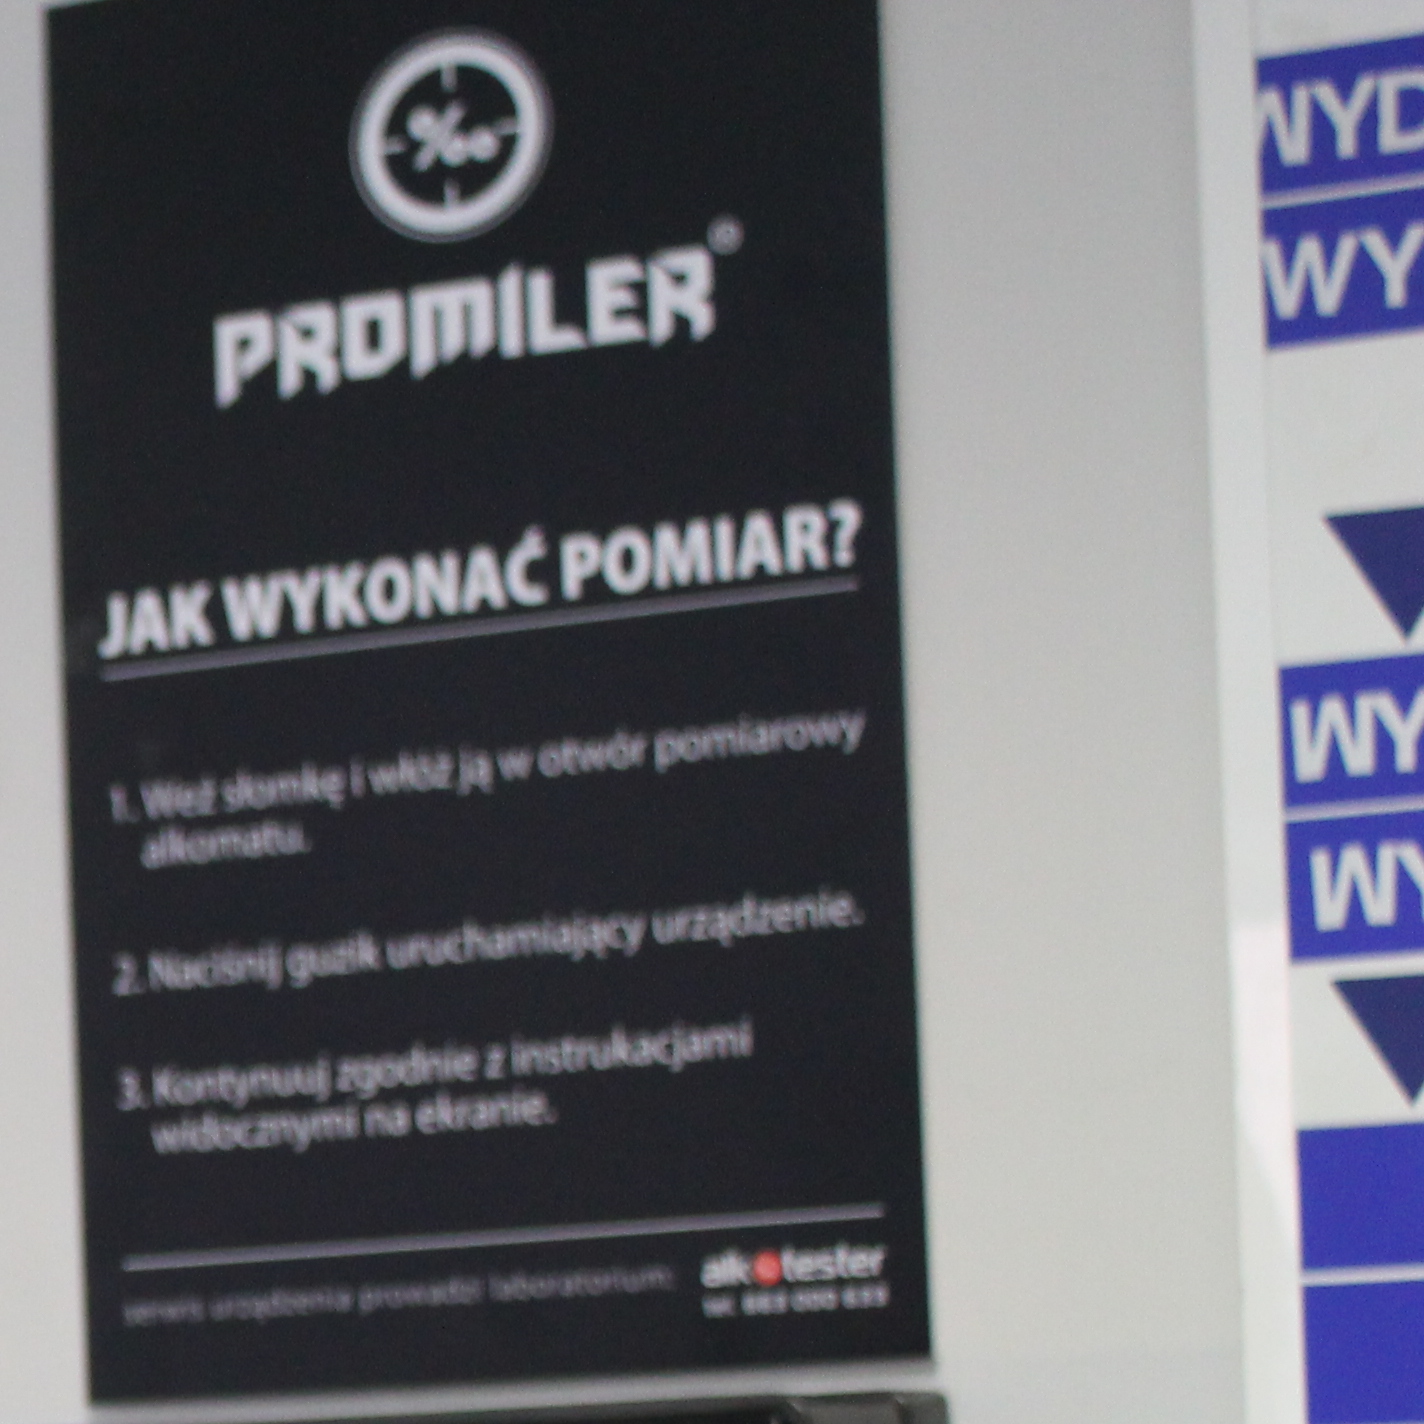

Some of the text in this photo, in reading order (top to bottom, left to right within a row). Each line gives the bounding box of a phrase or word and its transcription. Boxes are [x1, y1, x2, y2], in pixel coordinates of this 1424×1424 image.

[1263, 222, 1424, 320] WY
[213, 243, 716, 408] PROMILER
[98, 499, 863, 660] JAK WYKONAĆ POMIAR?
[497, 746, 534, 782] w
[536, 727, 649, 780] otwór
[653, 710, 867, 775] pomiarowy
[1289, 685, 1424, 784] WY
[139, 821, 312, 870] alkomatu.
[385, 914, 645, 968] uruchamiający
[651, 888, 865, 948] urządzenie.
[334, 1042, 479, 1102] zgodnie
[363, 1100, 411, 1138] na
[413, 1086, 558, 1136] ekranie.
